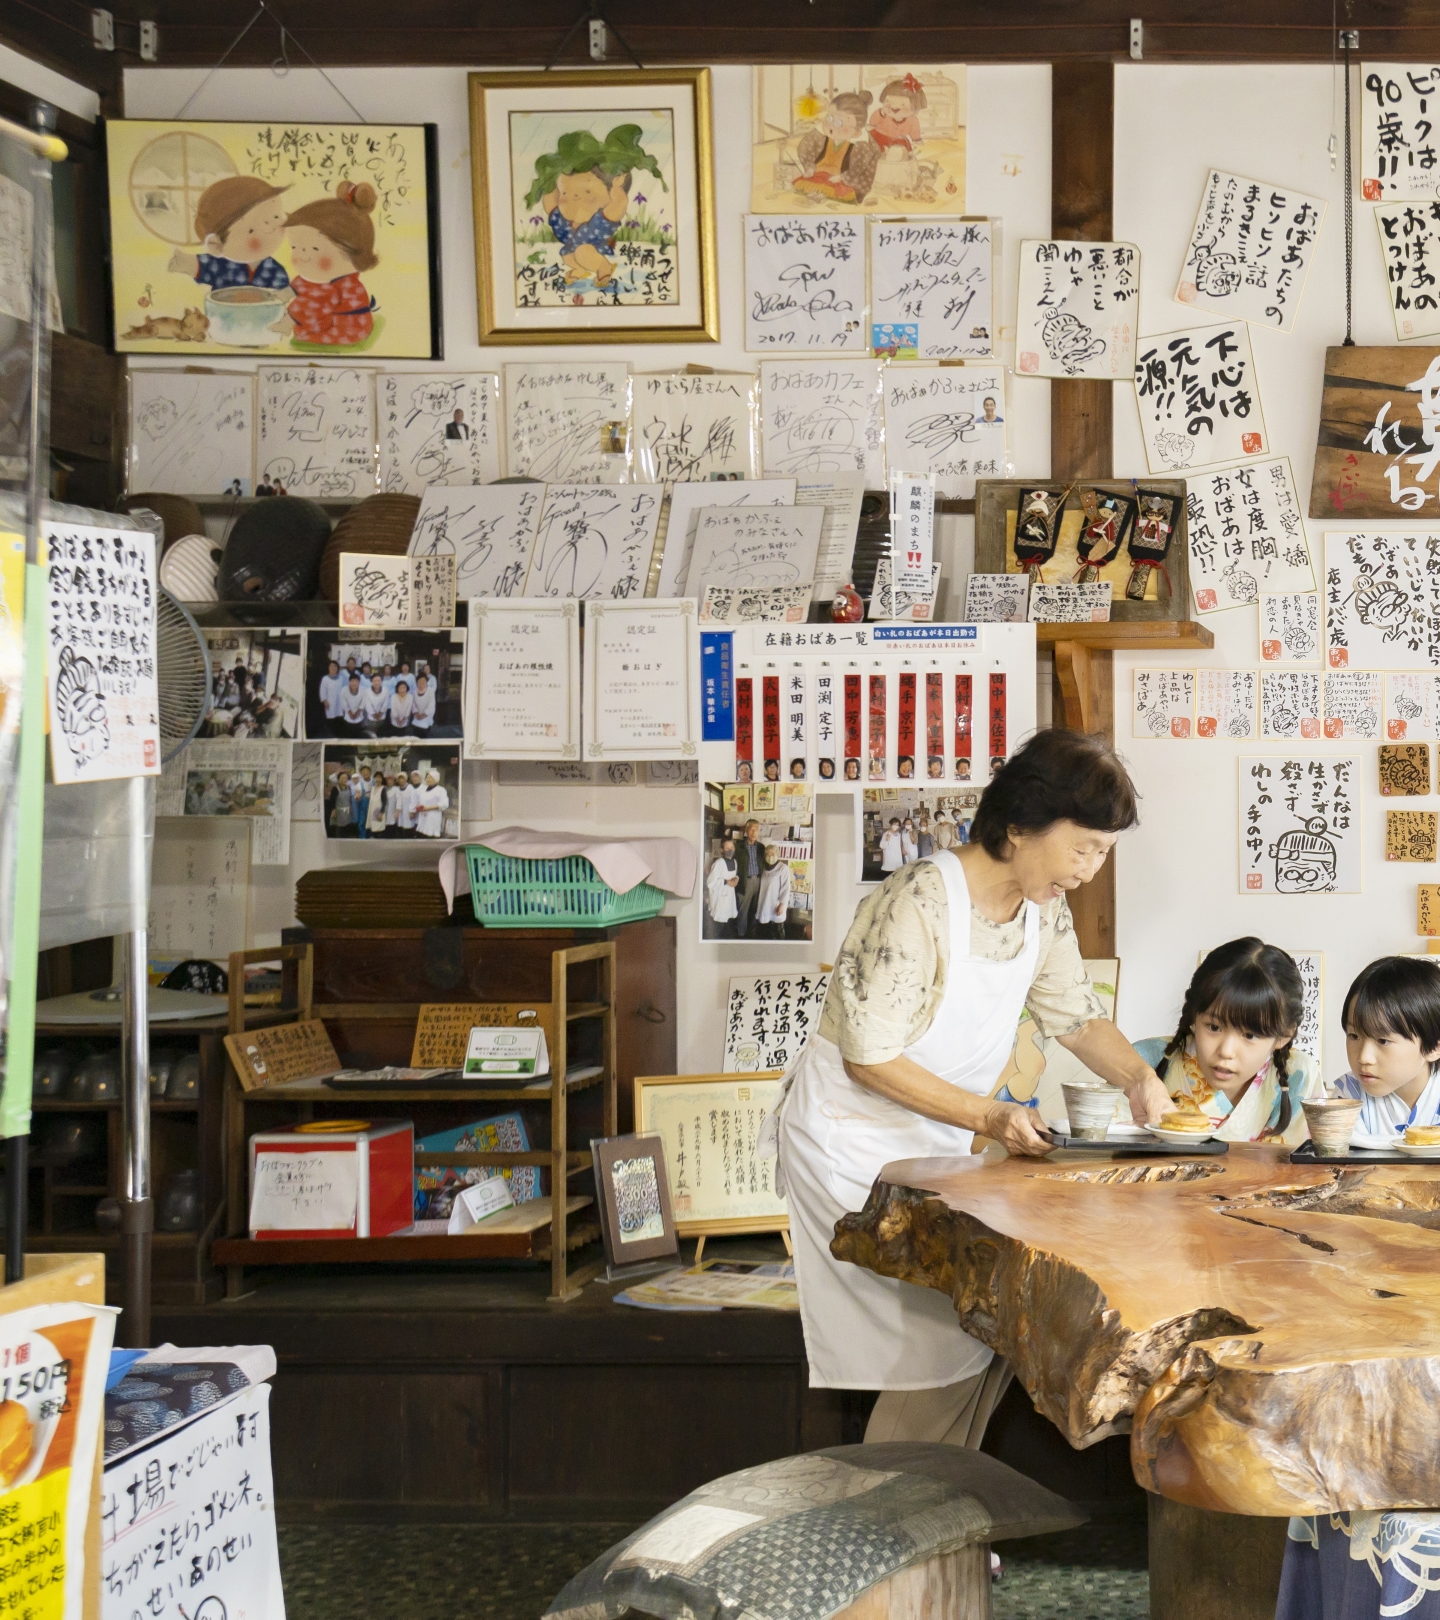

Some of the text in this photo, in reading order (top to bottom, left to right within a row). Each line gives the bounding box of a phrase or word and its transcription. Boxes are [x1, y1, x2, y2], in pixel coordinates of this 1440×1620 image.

[1365, 73, 1411, 191] 90歳!!
[822, 241, 852, 261] 様
[1112, 246, 1138, 303] 都合が
[1265, 202, 1319, 325] おばあたちの
[1403, 207, 1438, 310] おばあの
[1086, 247, 1109, 312] 悪いこと
[648, 379, 741, 397] ゆむら屋さんへ
[771, 370, 865, 391] おばあカフェ
[1136, 349, 1175, 421] 源!!
[1168, 338, 1216, 437] 元気の
[1206, 331, 1253, 419] 下心は
[704, 514, 781, 528] おばあかふぇ
[734, 527, 803, 538] のみなさんへ
[909, 486, 921, 551] 麒麟のまち
[1186, 491, 1218, 574] 最恐!!
[1212, 475, 1246, 558] おばあは
[1235, 468, 1279, 578] 女は度胸!
[1269, 465, 1309, 567] 男は愛嬌
[1346, 534, 1373, 573] だもの
[1373, 536, 1399, 578] おばあ
[1266, 596, 1279, 634] 初恋の人
[1307, 596, 1317, 631] 同窓会
[1403, 537, 1425, 651] ていいじゃないか
[511, 624, 540, 634] 認定証
[626, 625, 657, 635] 認定証
[764, 631, 869, 647] 在籍おばあ一覧
[720, 641, 730, 709] 食品衛生責任者
[738, 680, 751, 708] 西村
[847, 677, 859, 703] 田中
[957, 677, 970, 705] 河村
[1169, 672, 1181, 702] 上品な
[791, 676, 804, 741] 米田 明美
[819, 711, 833, 740] 定子
[900, 710, 914, 740] 京子
[928, 711, 943, 753] 八重子
[991, 674, 1005, 753] 田中 美佐子
[1280, 761, 1303, 812] 殺さず
[1308, 761, 1329, 814] 生かさず
[1333, 761, 1352, 829] だんなは
[1246, 763, 1272, 868] わしの手の中!
[727, 989, 748, 1054] おばあかふぇ
[752, 979, 771, 1047] 行かれます。
[1, 1358, 72, 1401] 150円
[3, 1342, 31, 1369] 1個
